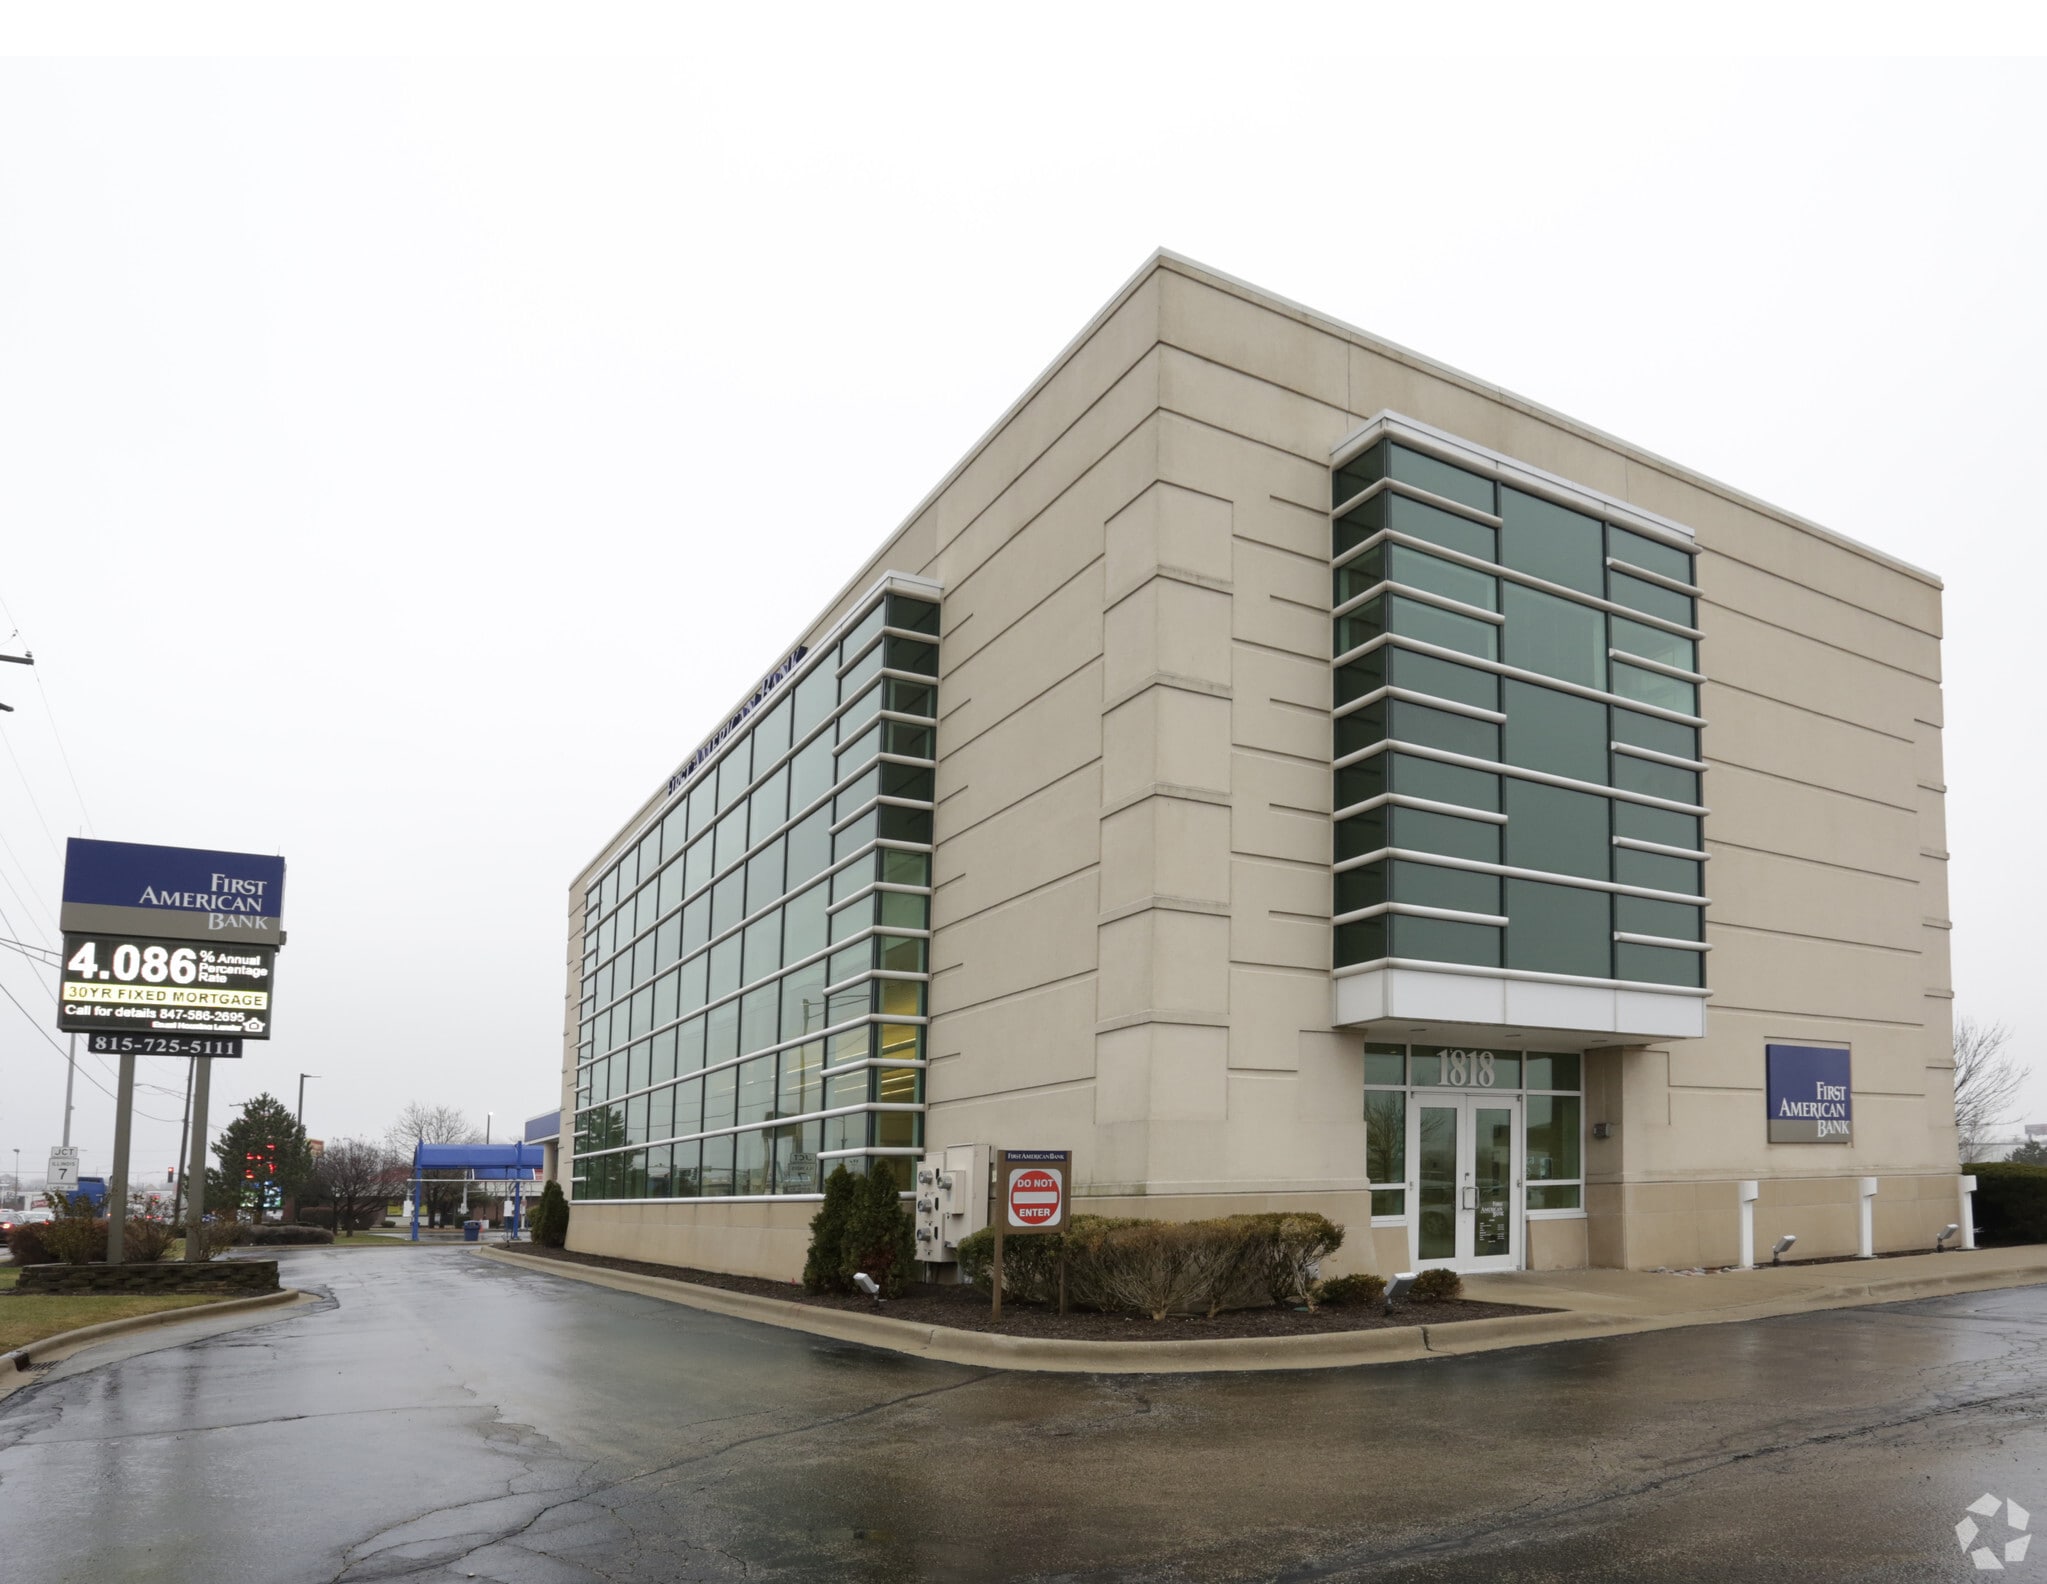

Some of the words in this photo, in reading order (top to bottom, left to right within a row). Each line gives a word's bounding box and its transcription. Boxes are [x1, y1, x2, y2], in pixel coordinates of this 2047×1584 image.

[211, 873, 267, 895] FIRST
[138, 885, 262, 912] AMERICAN
[208, 912, 268, 930] BANK
[67, 941, 197, 984] 4.086
[217, 953, 261, 966] Annual
[199, 962, 268, 978] Percentage
[198, 972, 228, 983] Rate
[69, 986, 112, 998] 30YR
[118, 989, 166, 1001] FIXED
[172, 991, 263, 1006] MORTGAGE
[64, 1004, 91, 1016] Call
[94, 1005, 113, 1017] for
[114, 1007, 157, 1018] details
[159, 1008, 245, 1022] 847-586-2695
[95, 1036, 235, 1054] 815-725-5111
[1437, 1048, 1495, 1087] 1818
[1816, 1081, 1847, 1101] FIRST
[1778, 1097, 1845, 1119] AMERICAN
[1816, 1119, 1850, 1138] BANK
[54, 1148, 74, 1156] JCT
[58, 1168, 68, 1180] 7
[1017, 1179, 1031, 1188] DO
[1034, 1179, 1054, 1188] NOT
[1019, 1208, 1051, 1217] ENTER
